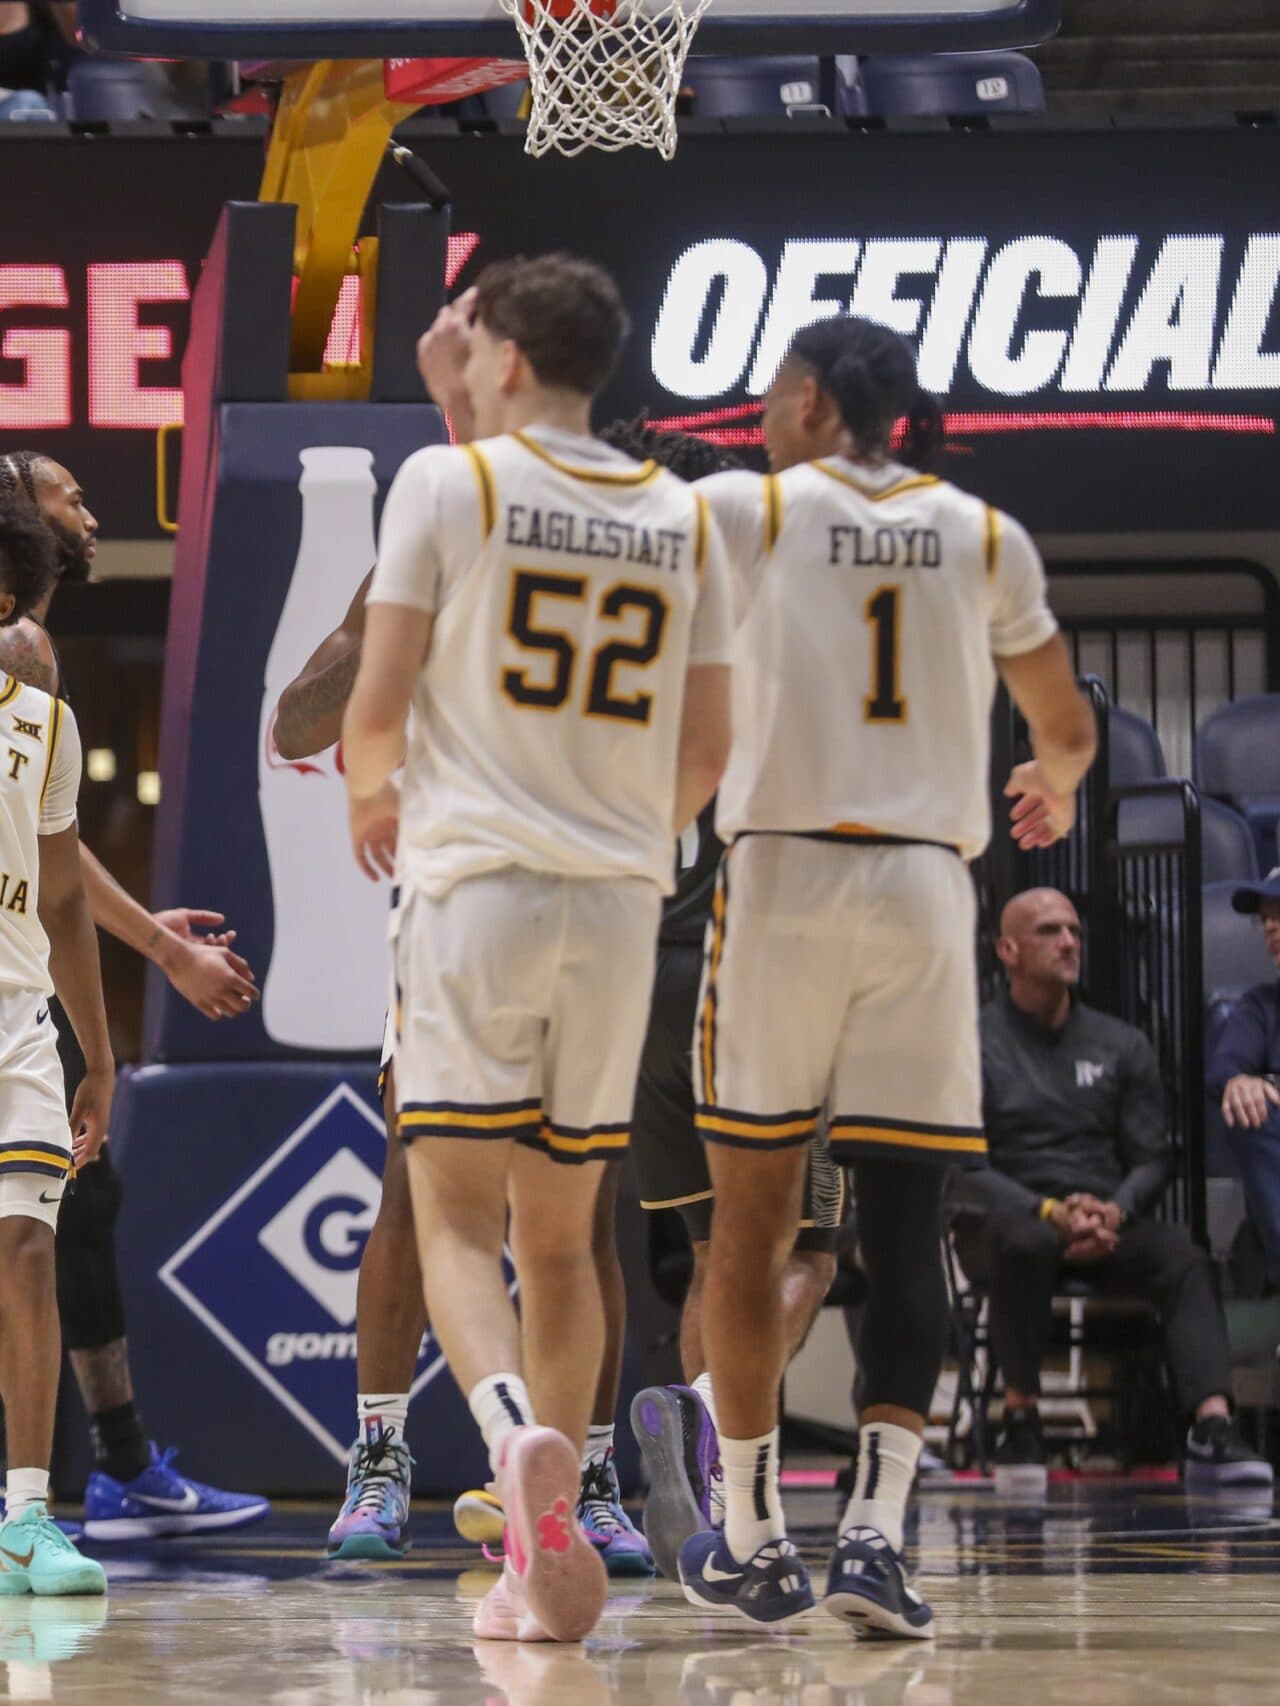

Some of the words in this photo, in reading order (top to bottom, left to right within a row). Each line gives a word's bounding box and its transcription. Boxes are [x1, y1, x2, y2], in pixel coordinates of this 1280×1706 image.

[650, 233, 1280, 399] OFFICIAL
[506, 505, 686, 572] EAGLESTAFF
[828, 525, 942, 569] FLOYD
[498, 567, 671, 728] 52
[863, 583, 908, 725] 1
[303, 1194, 376, 1272] G
